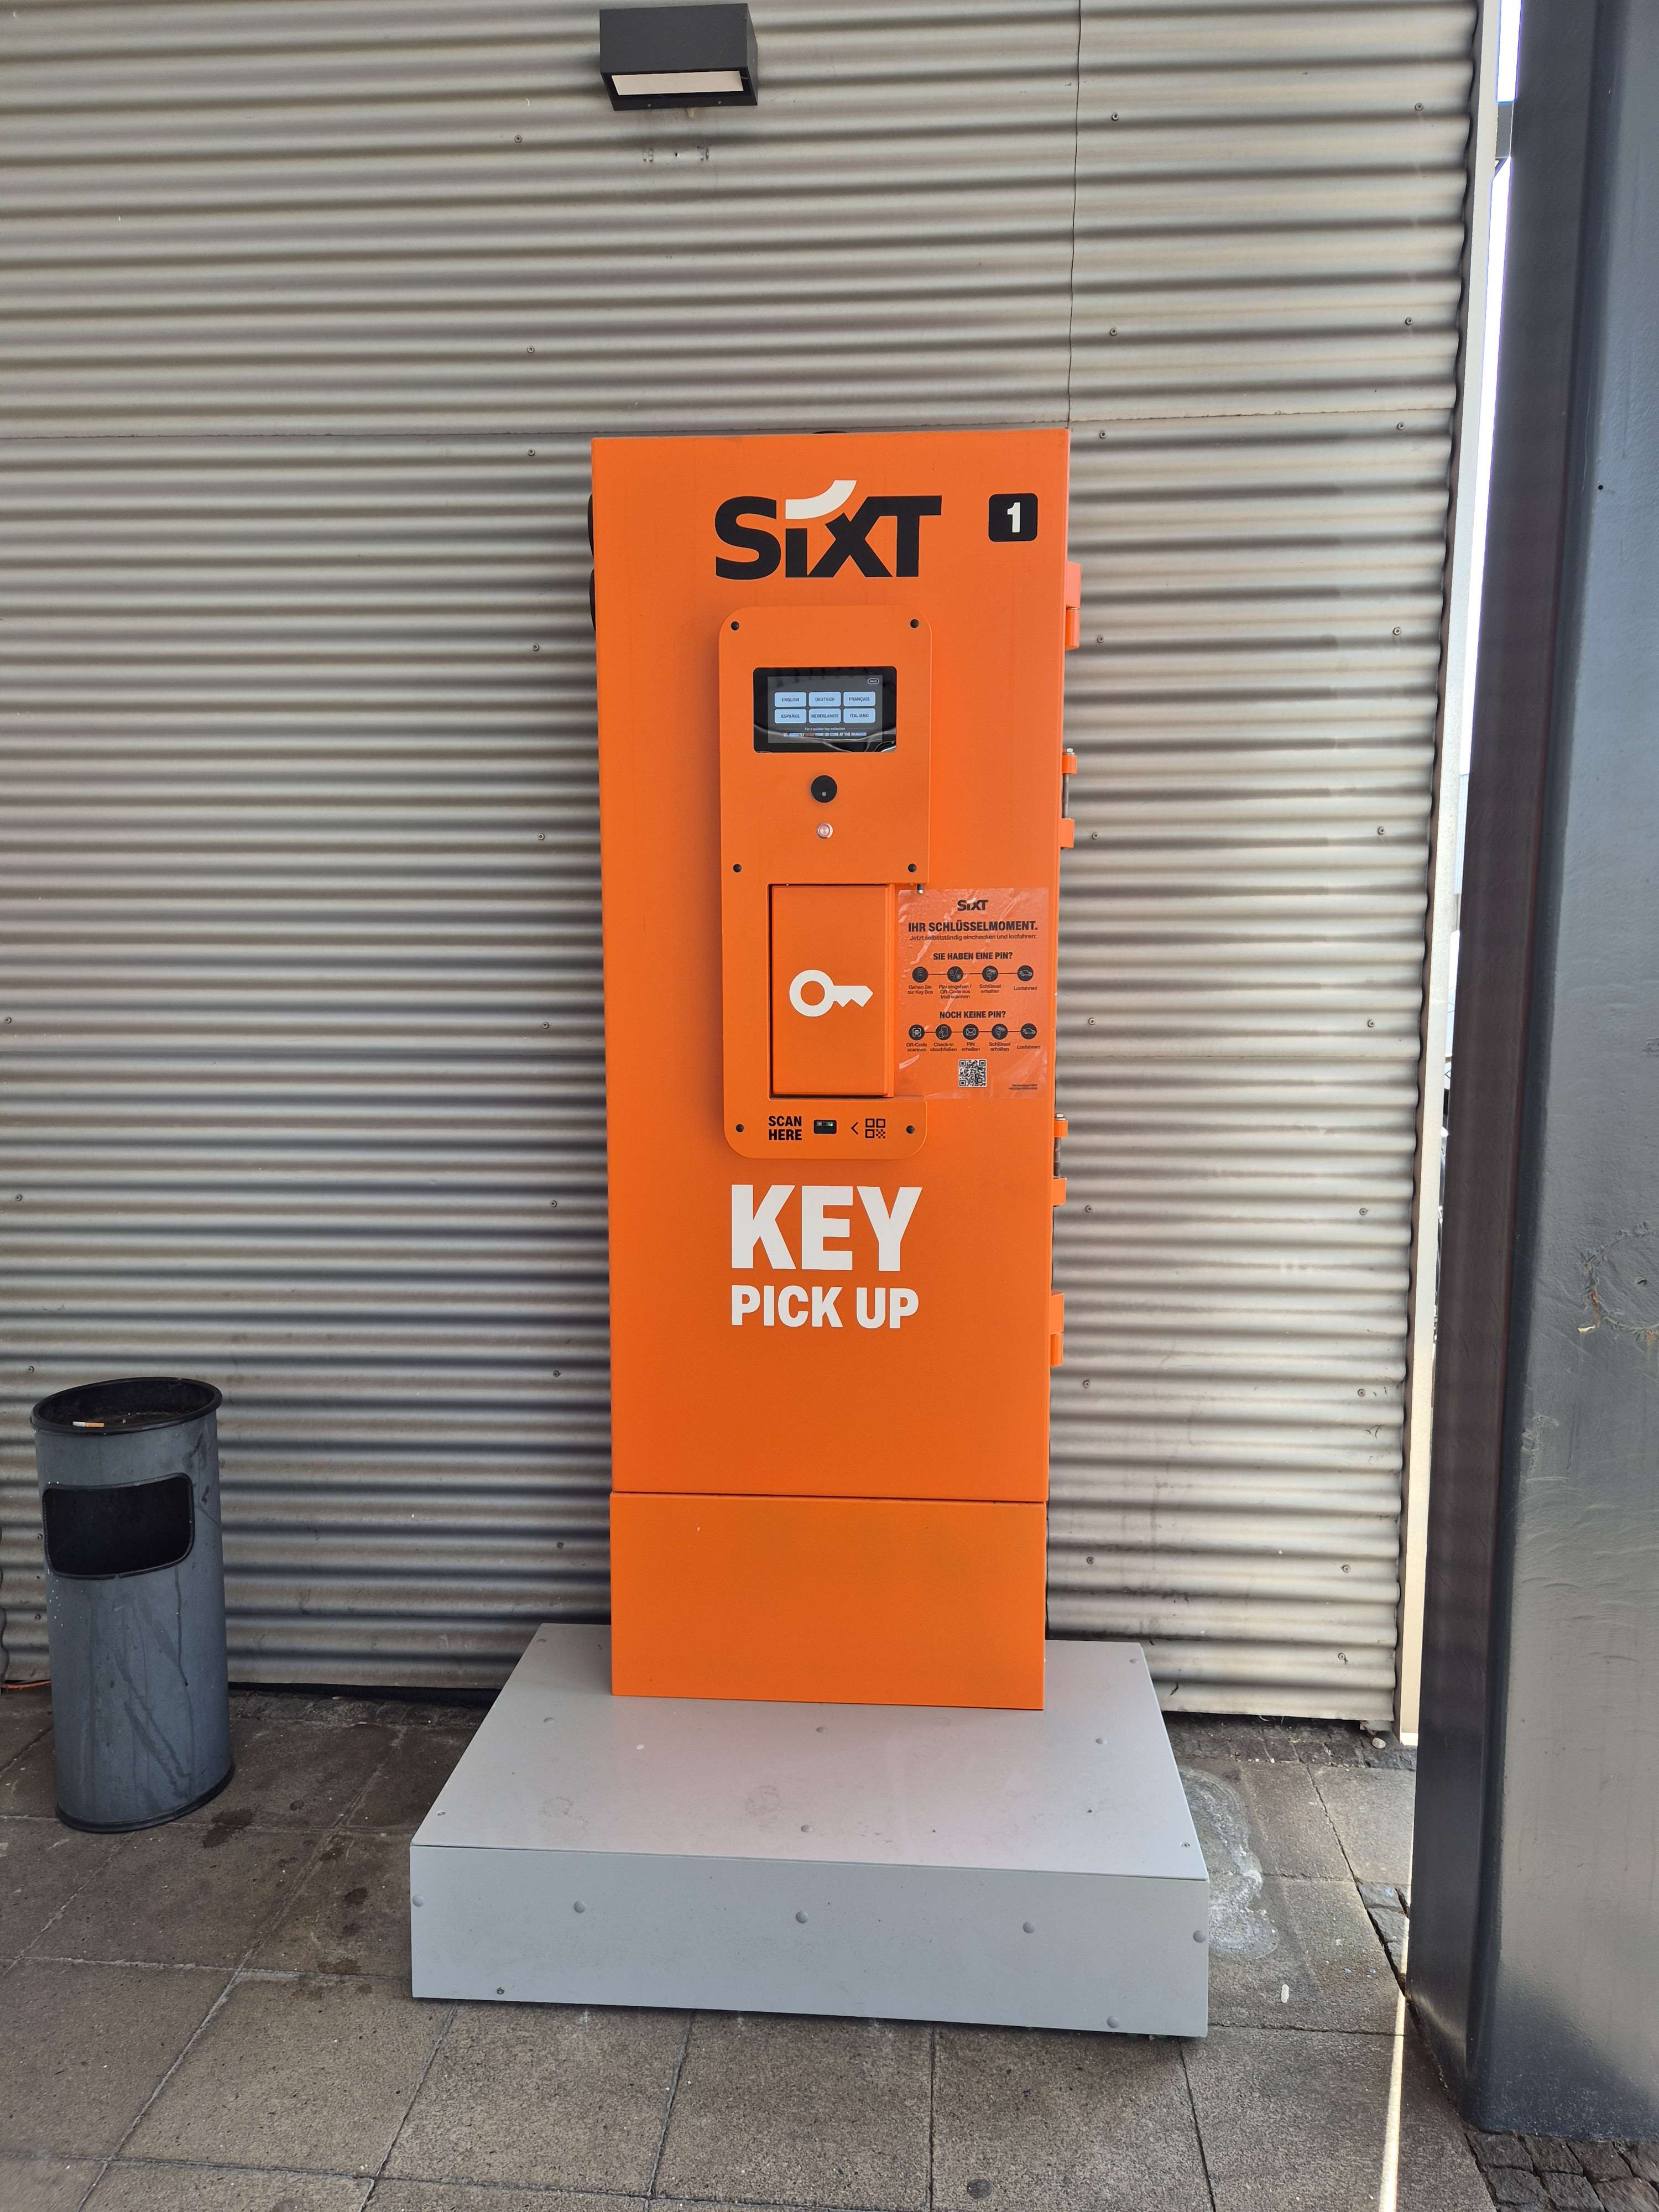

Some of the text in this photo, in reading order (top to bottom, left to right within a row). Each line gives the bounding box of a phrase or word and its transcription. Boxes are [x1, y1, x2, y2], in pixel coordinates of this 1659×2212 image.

[1006, 502, 1021, 533] 1
[909, 920, 1038, 932] IHR SCHLÜSSELMOMENT.
[768, 1115, 802, 1126] SCAN
[769, 1129, 802, 1141] HERE
[731, 1184, 923, 1272] KEY
[731, 1285, 919, 1329] PICK UP
